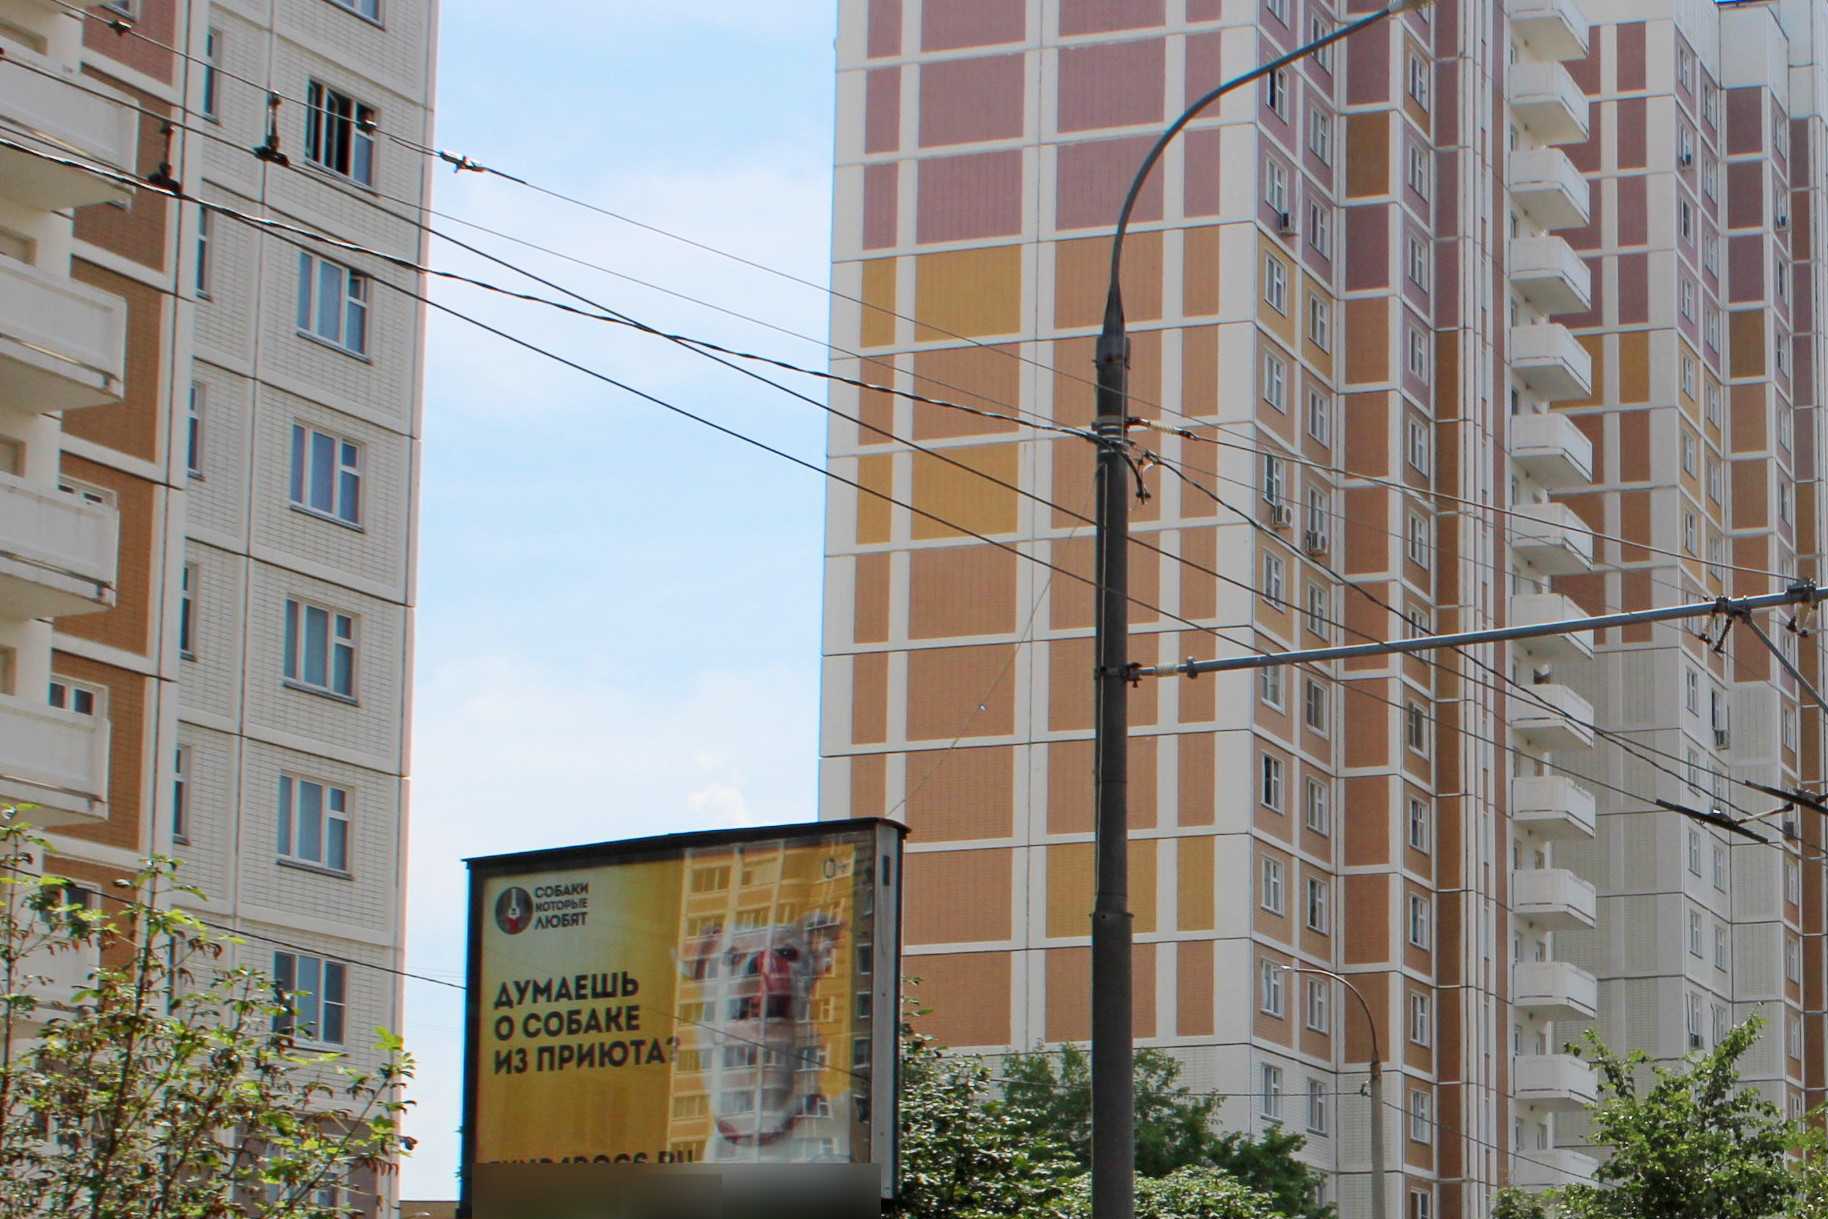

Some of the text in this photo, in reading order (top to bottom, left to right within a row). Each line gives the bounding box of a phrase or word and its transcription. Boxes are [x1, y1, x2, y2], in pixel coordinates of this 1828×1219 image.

[534, 883, 589, 899] СОБАКИ
[535, 898, 588, 913] КОТОРЫЕ
[534, 912, 588, 930] ЛЮБЯТ
[494, 972, 640, 1010] ДУМАЕШЬ
[494, 1005, 641, 1041] О СОБАКЕ
[494, 1036, 680, 1075] ИЗ ПРИЮТА?
